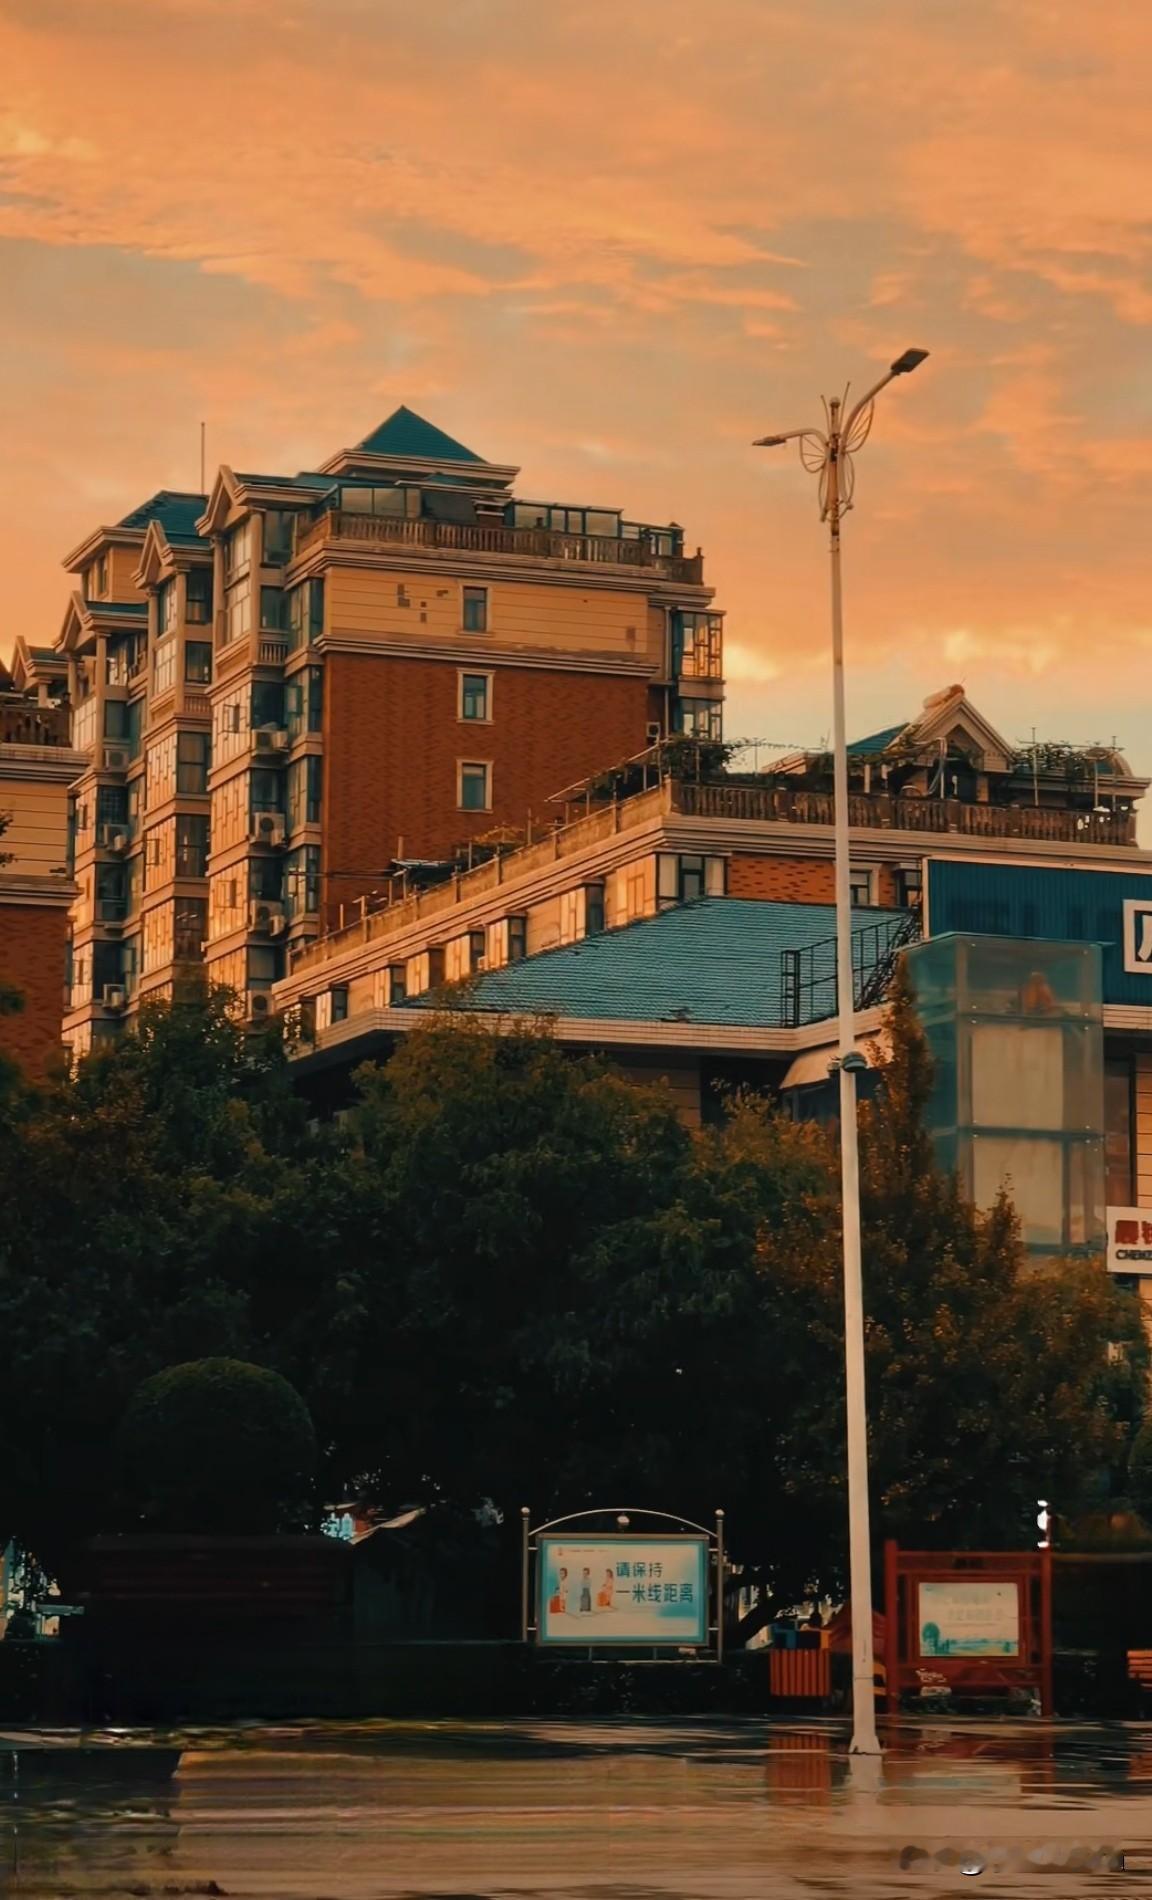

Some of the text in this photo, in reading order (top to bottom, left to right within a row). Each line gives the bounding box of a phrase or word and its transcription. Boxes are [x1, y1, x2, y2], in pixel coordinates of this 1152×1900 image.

[616, 1562, 663, 1578] 请保持
[616, 1583, 693, 1603] 一米线距离
